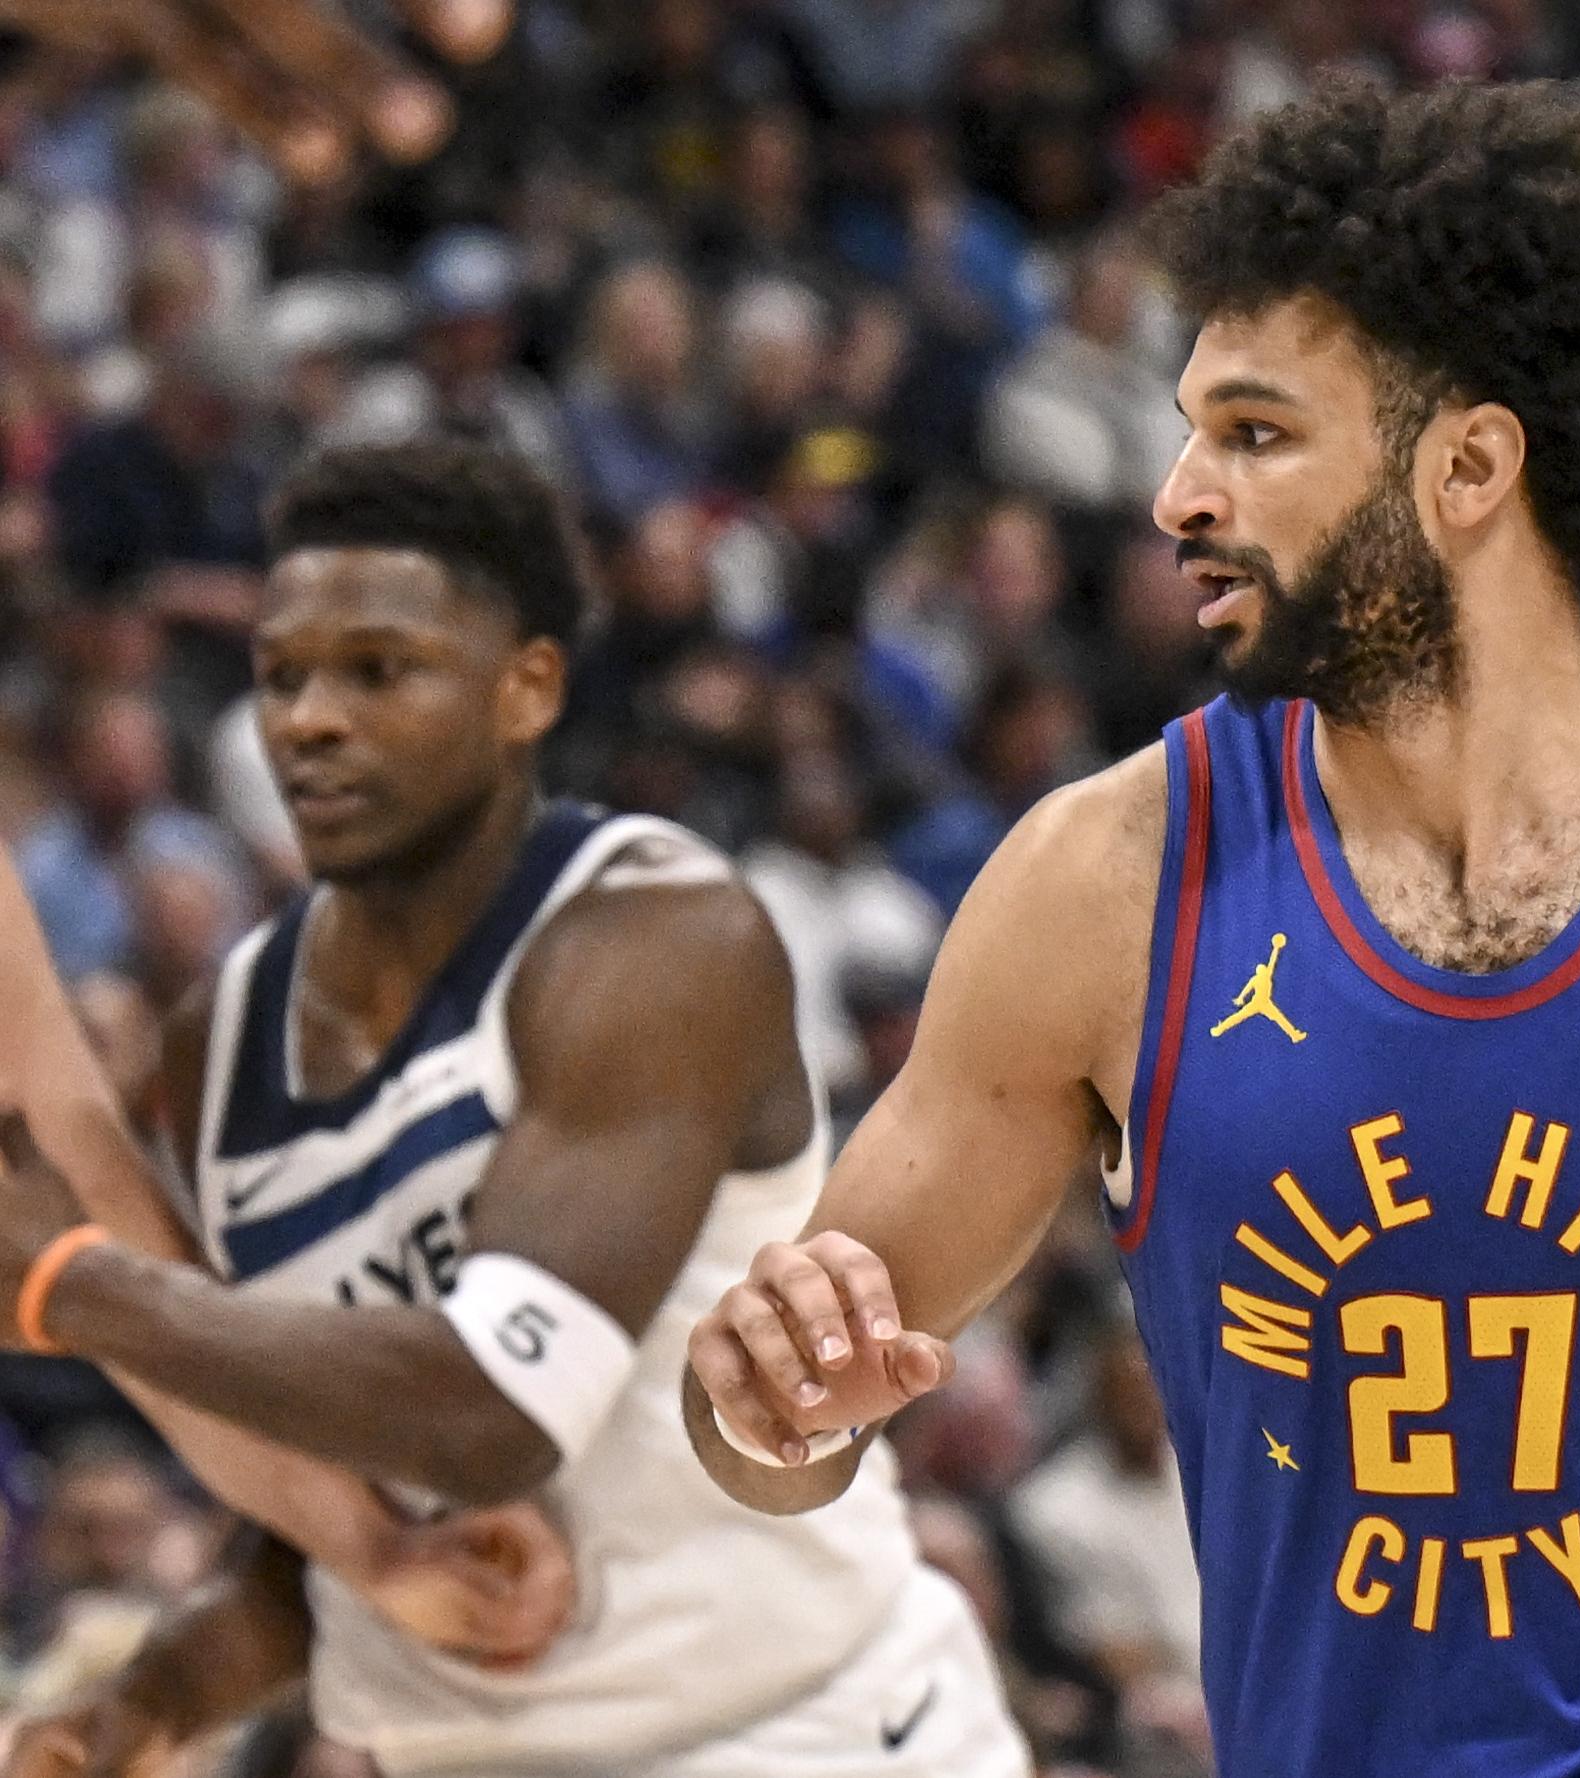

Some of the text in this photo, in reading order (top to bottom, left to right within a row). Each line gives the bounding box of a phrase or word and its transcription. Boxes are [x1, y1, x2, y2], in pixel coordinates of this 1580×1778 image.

[496, 1303, 559, 1364] 5
[1219, 1108, 1433, 1380] MILE
[1338, 1290, 1578, 1496] 27
